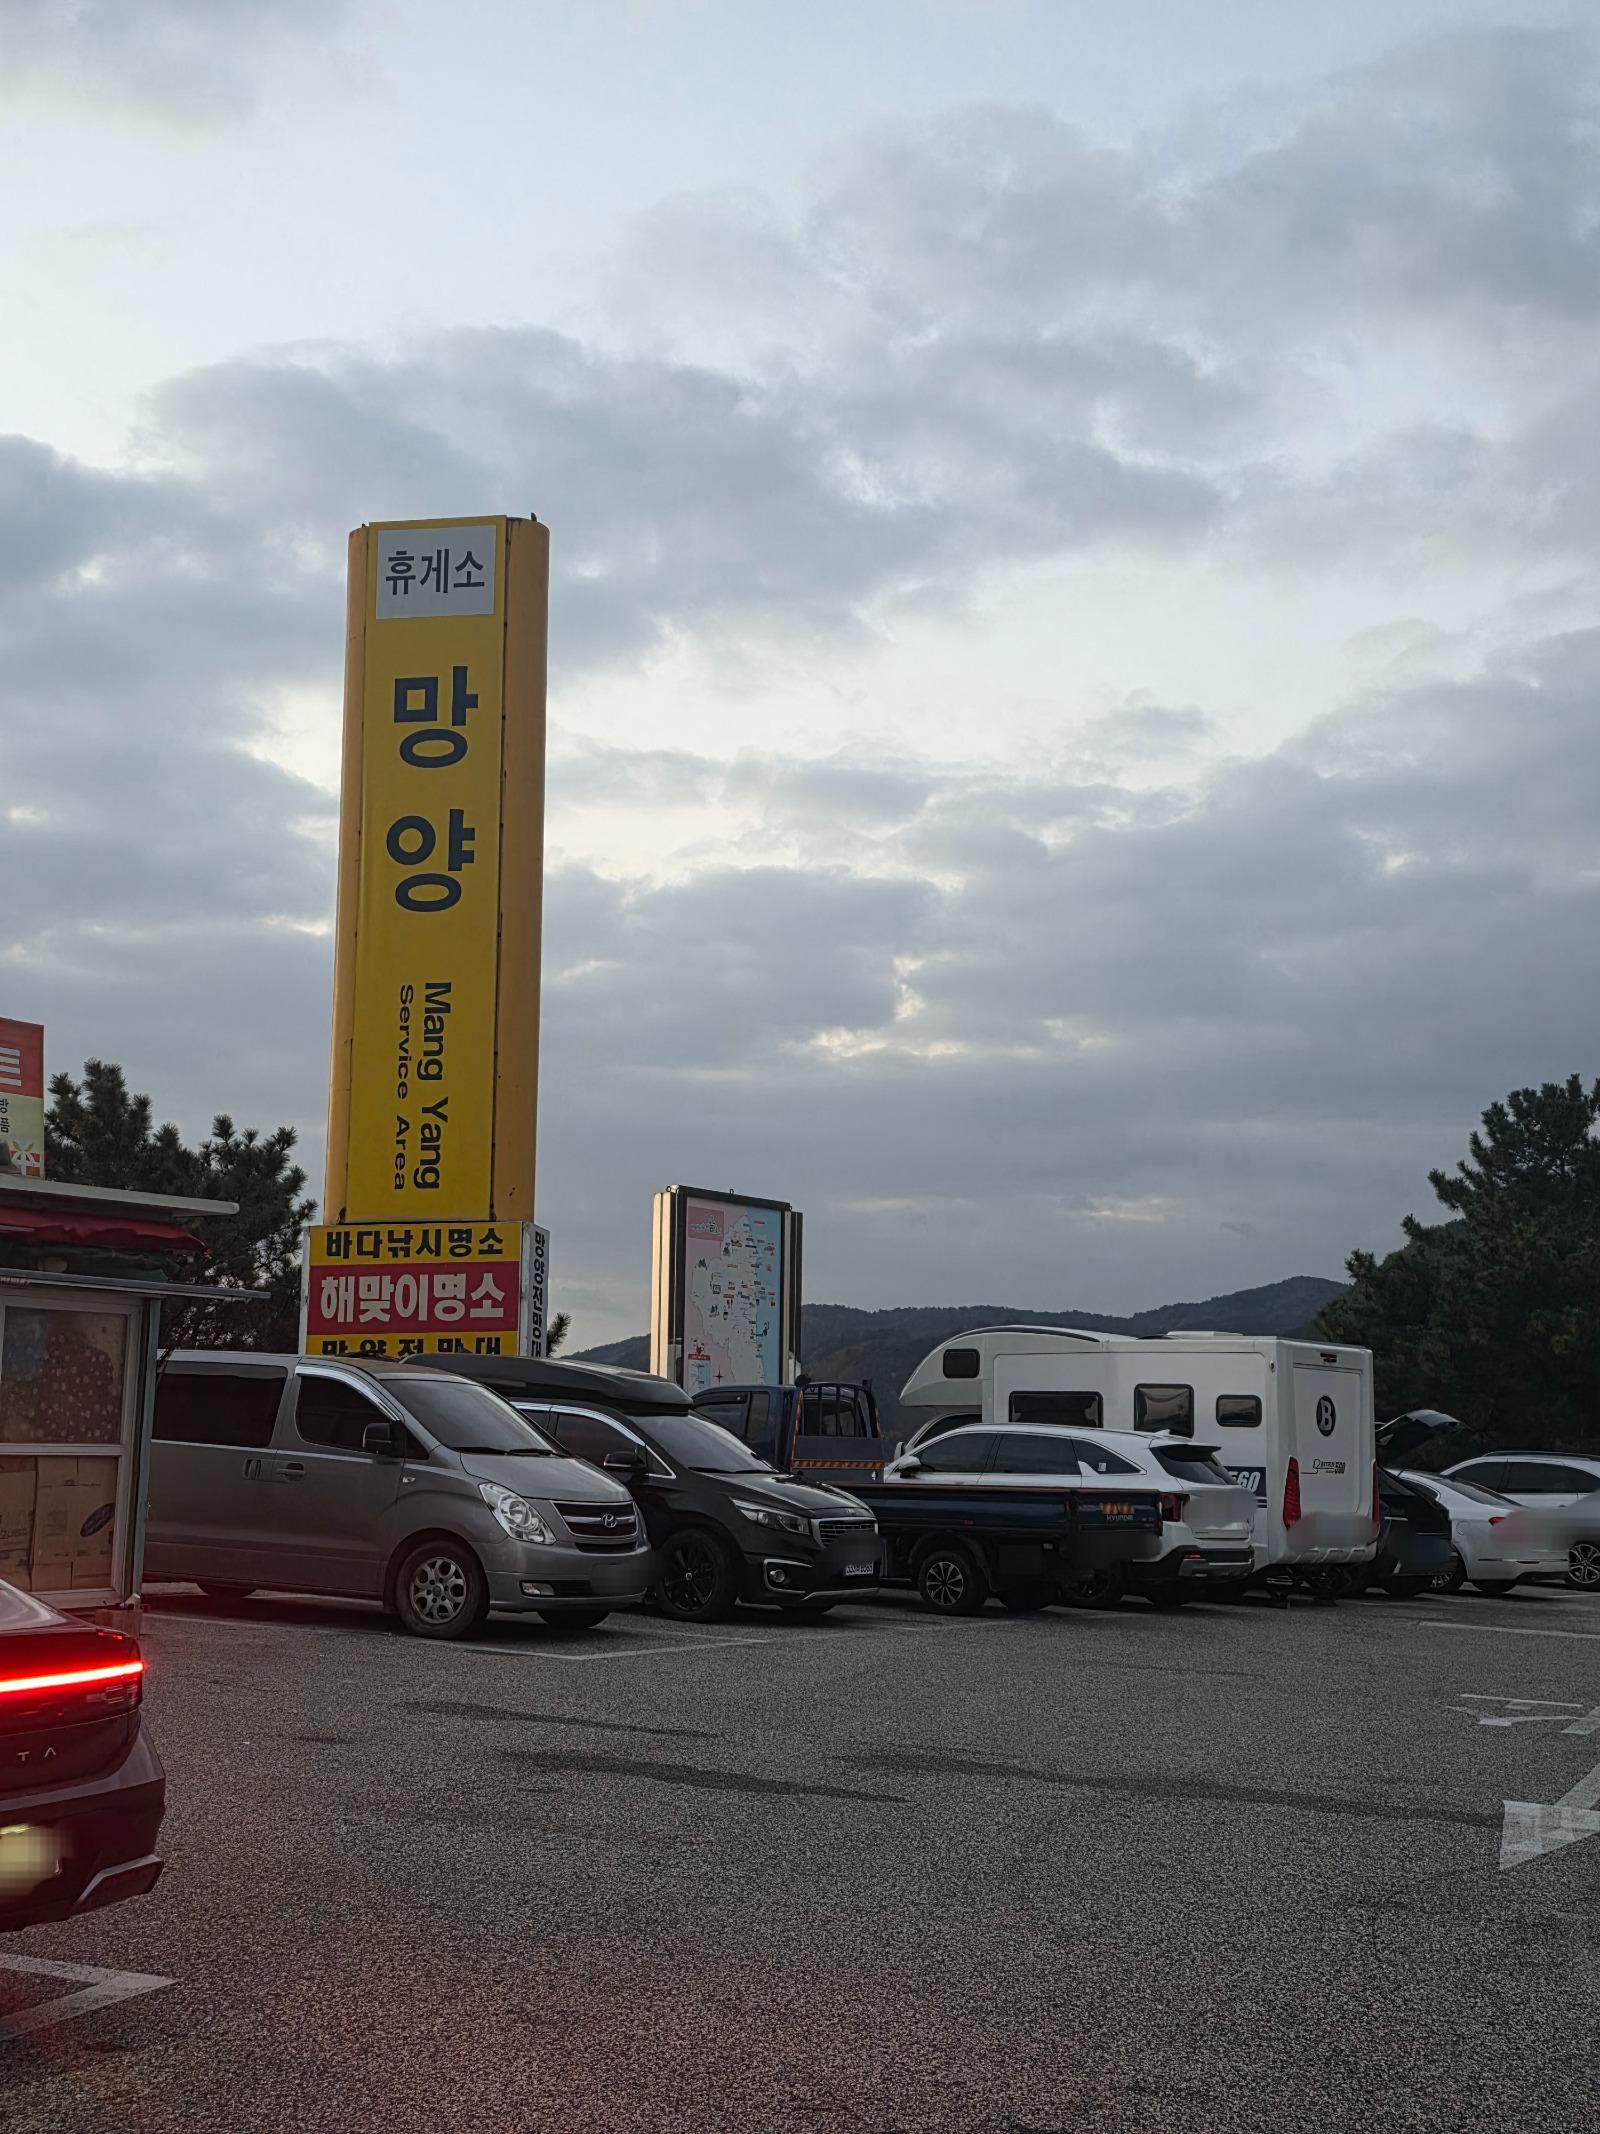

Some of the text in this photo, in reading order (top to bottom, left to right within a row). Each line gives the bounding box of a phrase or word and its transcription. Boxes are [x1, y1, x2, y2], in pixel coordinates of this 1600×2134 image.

[385, 549, 485, 595] 휴게소
[394, 984, 414, 1190] Service Area
[413, 982, 452, 1190] Mang Yang
[326, 1227, 504, 1260] 바다낚시명소
[320, 1272, 505, 1324] 해맞이명소
